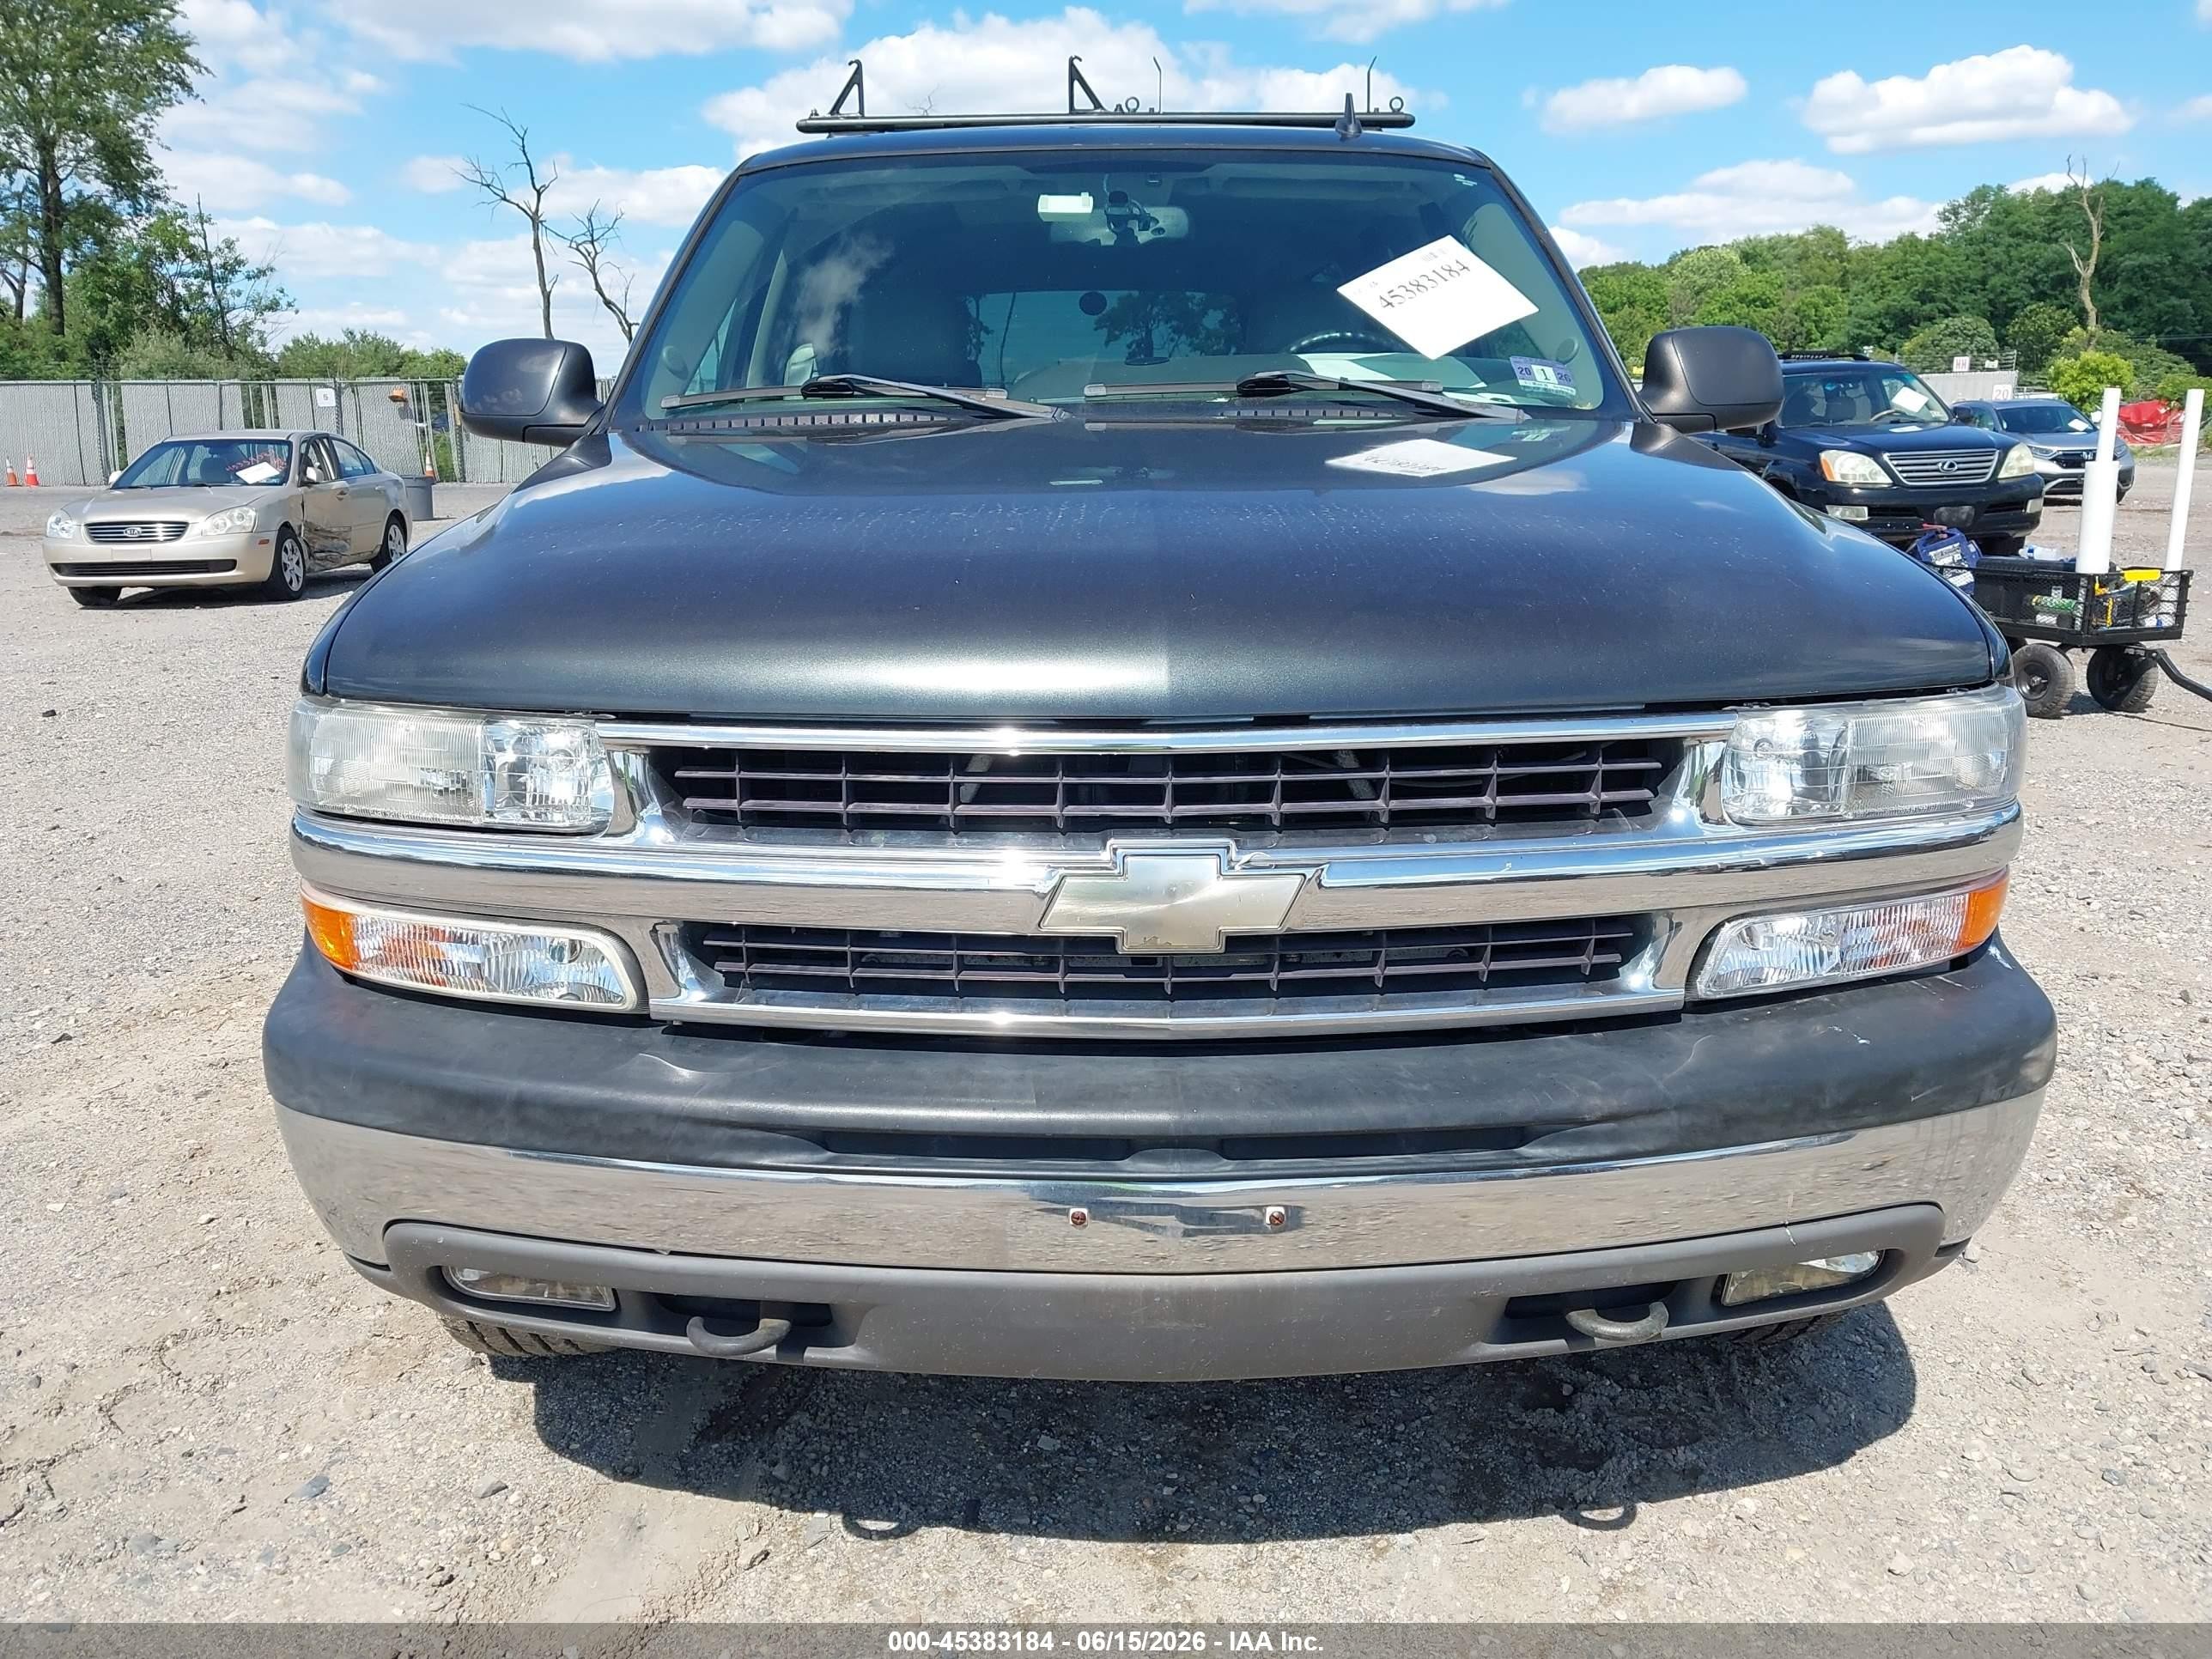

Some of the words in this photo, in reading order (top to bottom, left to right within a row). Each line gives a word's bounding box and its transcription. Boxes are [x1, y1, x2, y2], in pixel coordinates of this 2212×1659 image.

[1379, 259, 1470, 308] 45383184
[1517, 366, 1532, 376] 20
[1540, 368, 1551, 381] 1
[1995, 389, 2009, 401] 20
